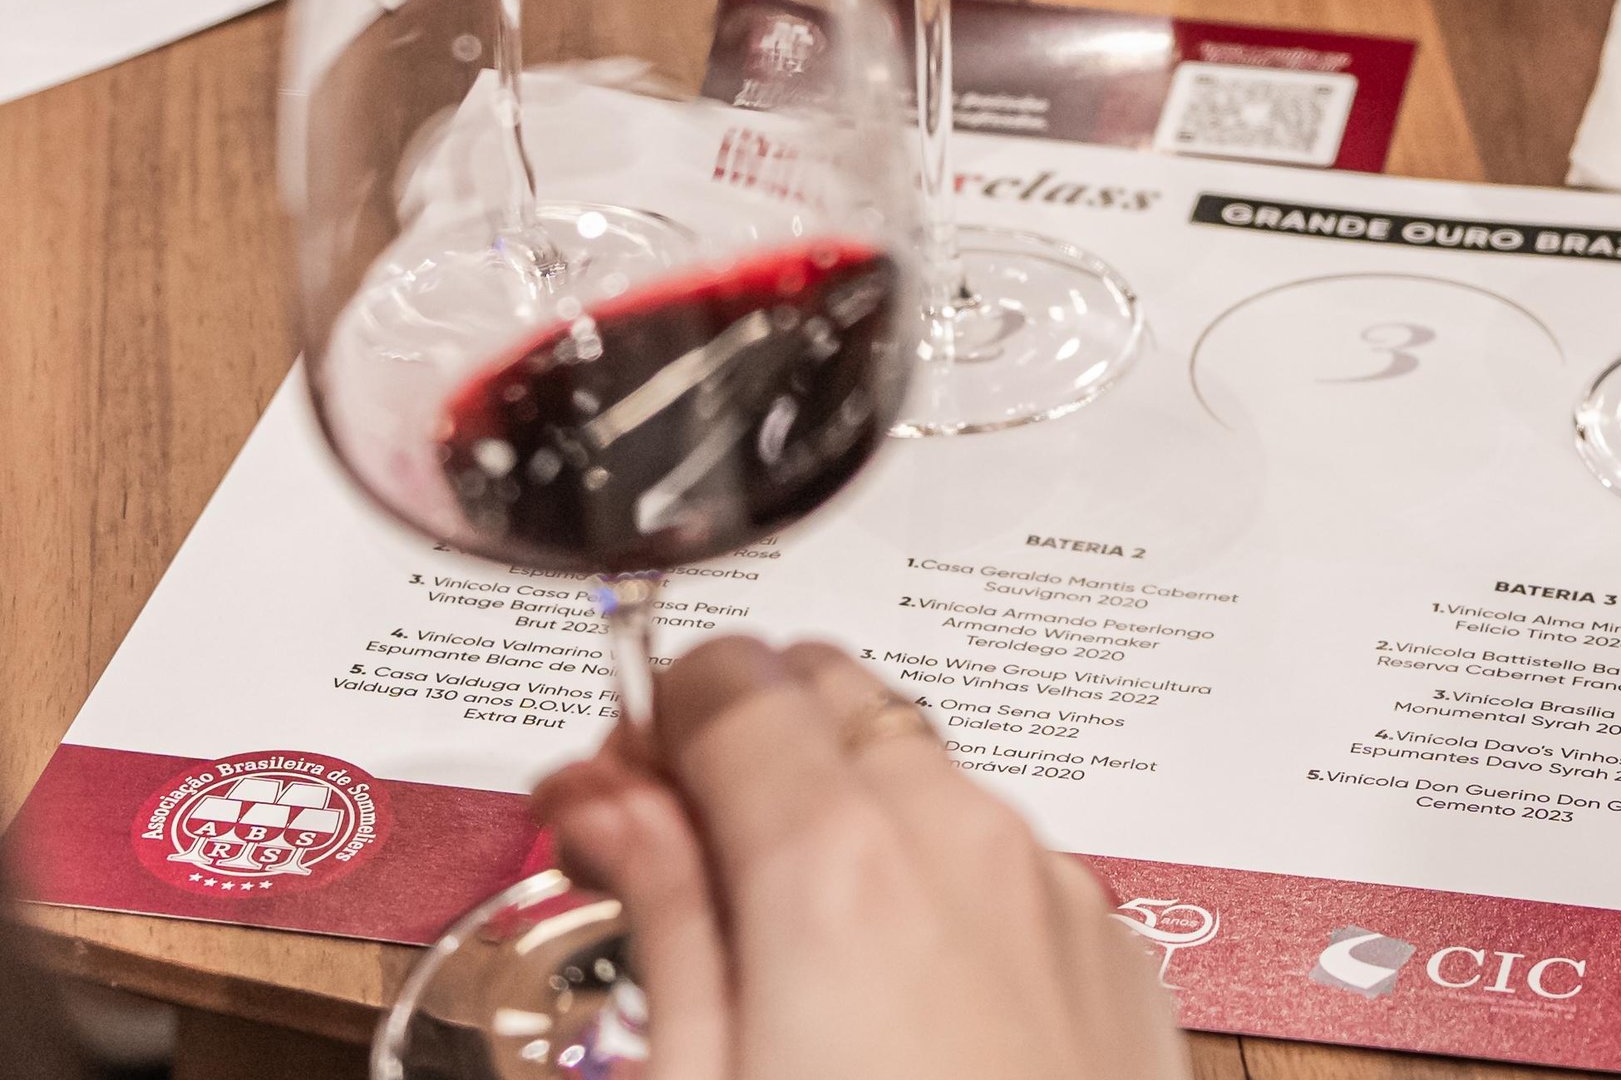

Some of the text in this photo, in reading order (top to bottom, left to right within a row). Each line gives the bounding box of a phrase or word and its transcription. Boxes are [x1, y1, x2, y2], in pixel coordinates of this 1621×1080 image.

[1221, 202, 1390, 240] GRANDE
[1401, 221, 1524, 250] OURO
[1025, 534, 1146, 559] BATERIA 2
[435, 577, 750, 616] Vinícola Casa Perini
[980, 566, 1239, 603] Geraldo Mantis Cabernet
[984, 581, 1148, 609] Sauvignon 2020
[1494, 581, 1618, 605] BATERIA 3
[429, 591, 595, 618] Vintage Barriqué
[515, 616, 610, 634] Brut 2023
[942, 617, 1160, 649] Armando Winemaker
[1001, 608, 1214, 640] Armando Peterlongo
[1456, 620, 1520, 636] Felício
[1528, 628, 1577, 643] Tinto
[1532, 615, 1584, 629] Alma
[365, 641, 576, 672] Espumante Blanc de
[418, 630, 603, 659] Vinícola Valmarino
[967, 635, 1125, 661] Teroldego 2020
[883, 651, 1212, 694] Miolo Wine Group Vitivinicultura
[1377, 656, 1459, 672] Reserva
[1466, 665, 1566, 685] Cabernet
[1482, 651, 1586, 671] Battistello
[334, 677, 418, 697] Valduga
[425, 686, 460, 701] 130
[463, 692, 516, 710] anos
[518, 696, 592, 715] D.O.V.V.
[374, 666, 429, 684] Casa
[433, 671, 522, 694] Valduga
[528, 680, 593, 700] Vinhos
[900, 669, 1159, 705] Miolo Vinhas Velhas 2022
[463, 708, 566, 729] Extra Brut
[940, 699, 1125, 727] Oma Sena Vinhos
[1394, 701, 1526, 724] Monumental
[1531, 715, 1590, 732] Syrah
[1540, 701, 1615, 719] Brasília
[948, 716, 1080, 738] Dialeto 2022
[944, 740, 1157, 772] Don Laurindo Merlot
[1350, 743, 1479, 765] Espumantes
[1486, 756, 1543, 772] Davo
[1548, 763, 1608, 780] Syrah
[1484, 739, 1554, 756] Davo's
[1031, 766, 1085, 780] 2020
[1415, 779, 1459, 794] Don
[1466, 784, 1550, 805] Guerino
[1557, 794, 1600, 809] Don
[142, 756, 377, 862] Associação Brasileira de Sommeliers
[1416, 796, 1573, 822] Cemento 2023
[1426, 946, 1586, 1000] CIC
